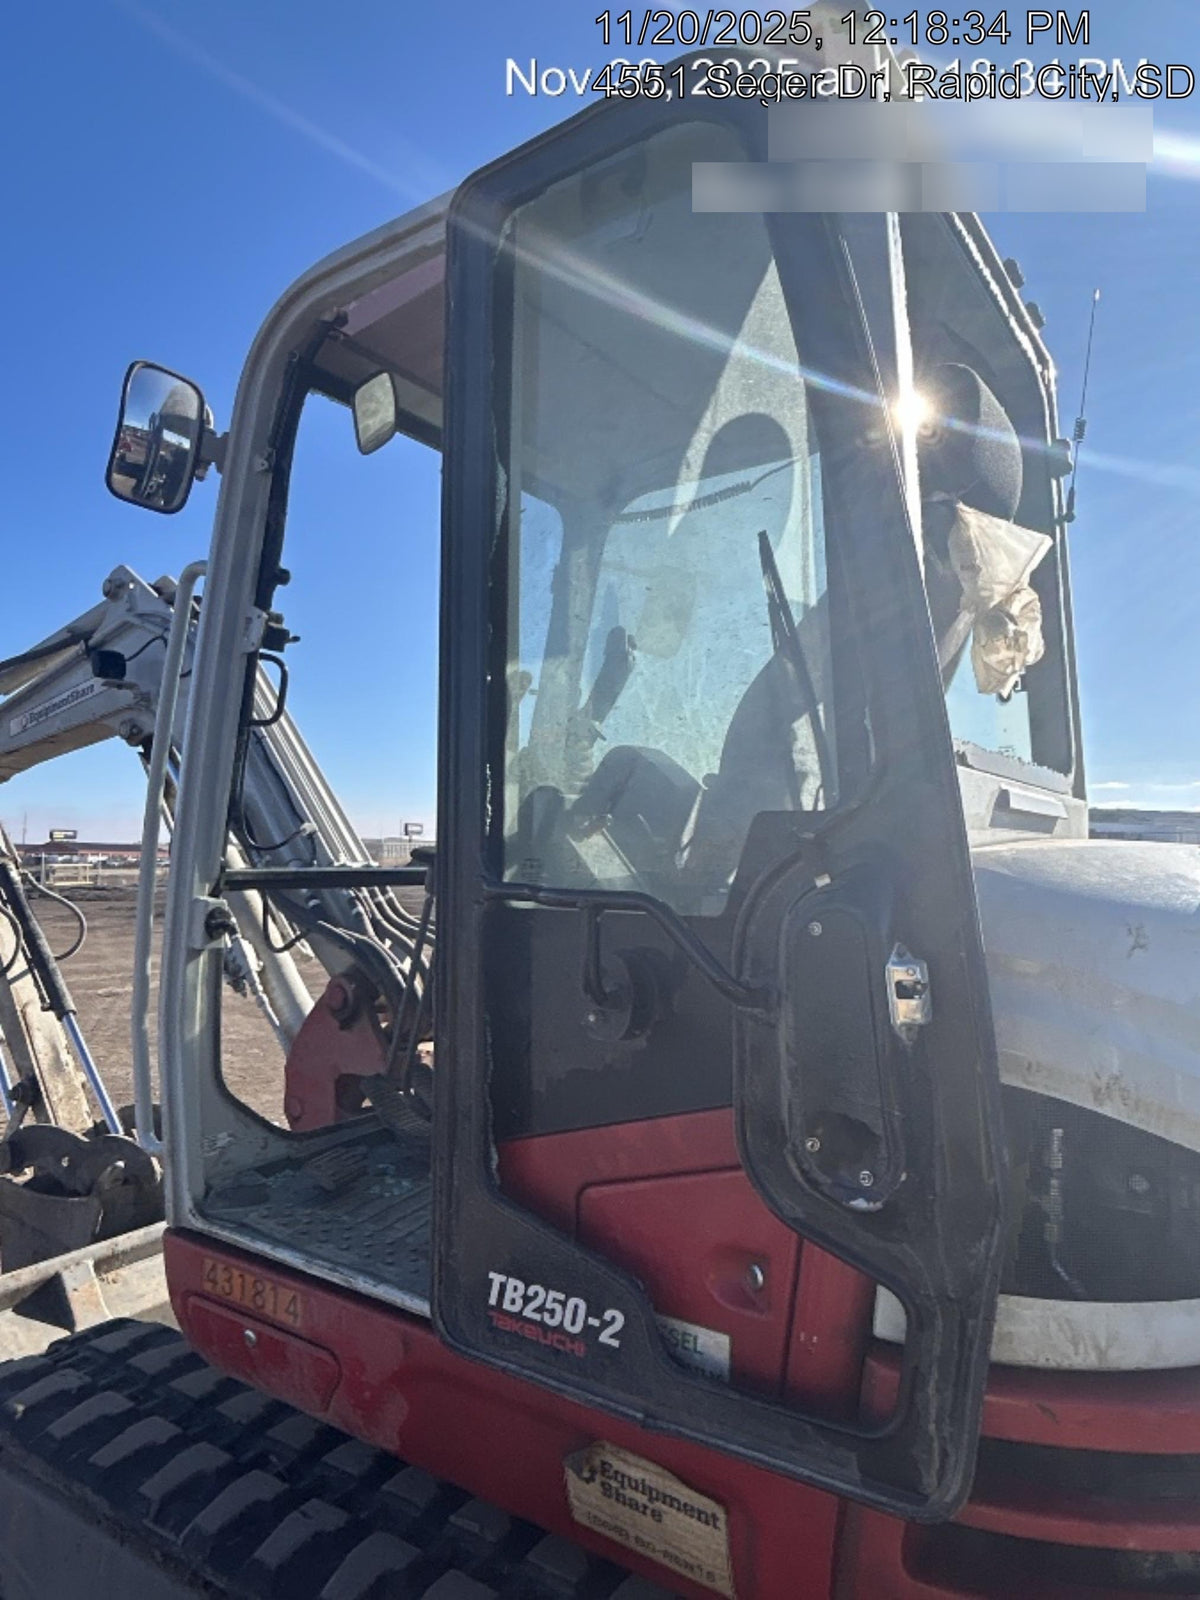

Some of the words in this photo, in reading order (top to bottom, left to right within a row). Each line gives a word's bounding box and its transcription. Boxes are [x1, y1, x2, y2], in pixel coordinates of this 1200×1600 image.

[207, 1263, 299, 1324] 431814
[487, 1271, 625, 1348] TB250-2
[600, 1459, 721, 1530] Equipment
[600, 1481, 664, 1524] Share
